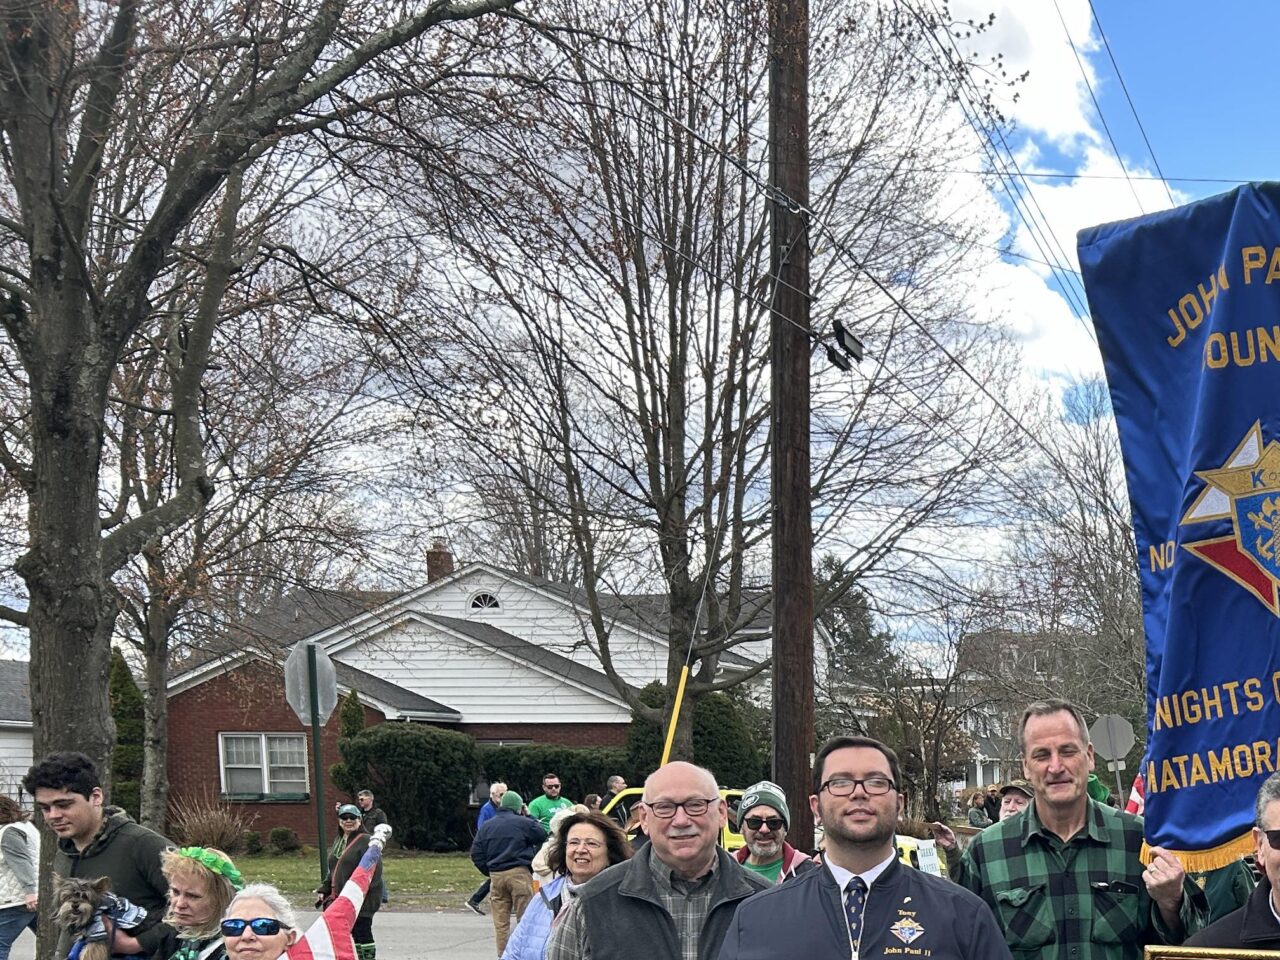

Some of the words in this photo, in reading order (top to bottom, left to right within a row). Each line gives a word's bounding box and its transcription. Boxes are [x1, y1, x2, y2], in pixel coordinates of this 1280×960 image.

[1250, 469, 1266, 488] K
[1153, 677, 1265, 732] NIGHTS
[897, 909, 917, 917] Tony
[883, 947, 902, 955] John
[904, 947, 922, 955] Paul
